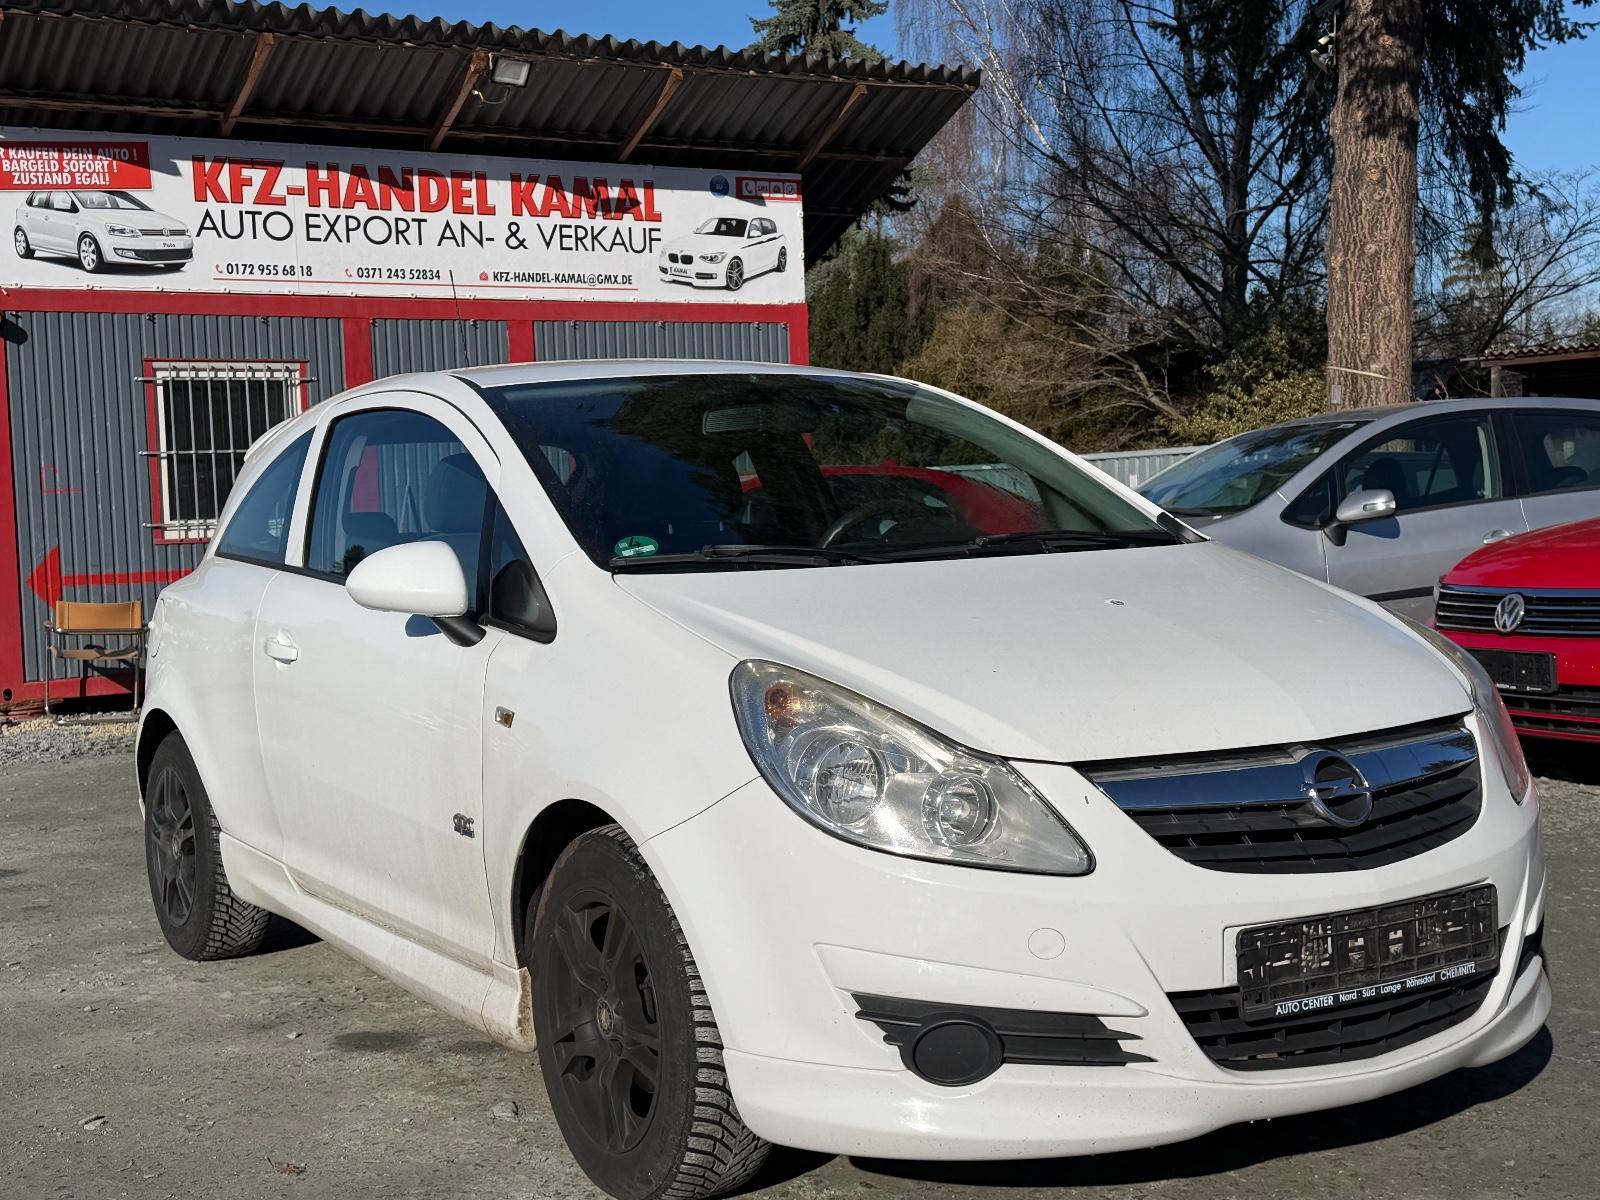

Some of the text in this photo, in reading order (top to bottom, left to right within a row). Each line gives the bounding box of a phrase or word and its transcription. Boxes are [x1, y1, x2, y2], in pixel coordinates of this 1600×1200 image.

[8, 146, 59, 160] KAUFEN
[62, 147, 94, 160] DEIN
[97, 147, 130, 161] AUTO
[2, 160, 60, 172] BARGELD
[62, 160, 110, 173] SOFORT
[12, 172, 110, 186] ZUSTAND EGAL!
[192, 155, 662, 222] KFZ-HANDEL KAMAL
[196, 208, 662, 254] AUTO EXPORT AN- & VERKAUF
[226, 263, 313, 277] 0172 955 68 18
[357, 267, 441, 280] 0371 243 52834
[493, 271, 633, 286] KFZ-HANDEL-KAMAL@GMX.DE
[1275, 1001, 1300, 1016] AUTO
[1301, 995, 1334, 1011] CENTER
[1339, 991, 1357, 1003] Nord
[1361, 987, 1376, 998] Süd
[1380, 982, 1402, 993] Lange
[1440, 963, 1476, 981] CHEMNITZ
